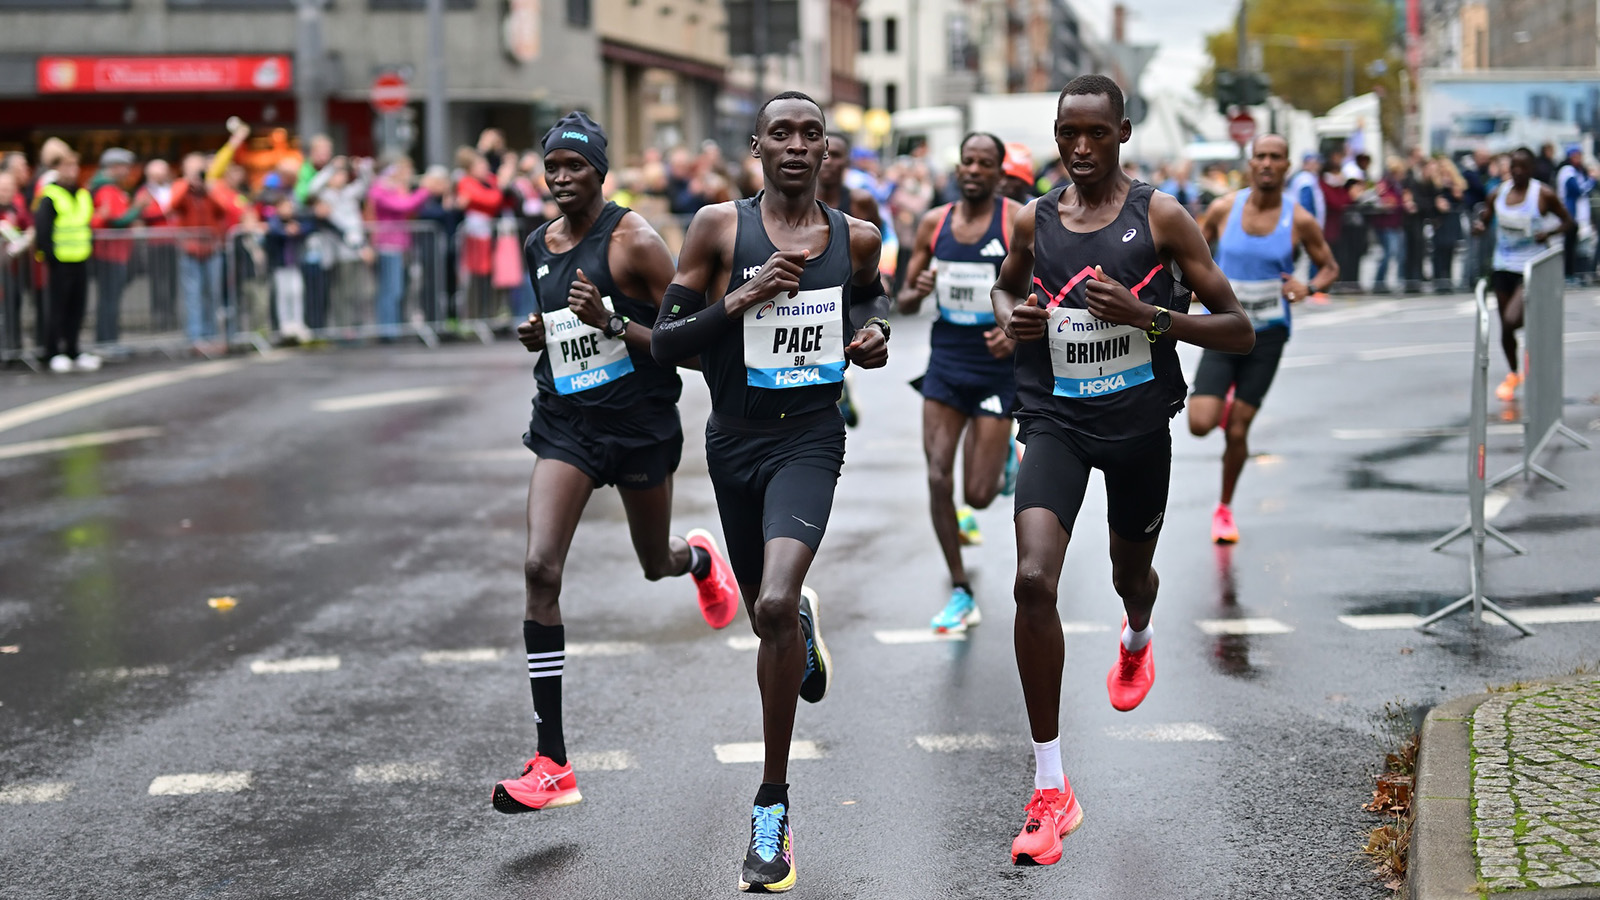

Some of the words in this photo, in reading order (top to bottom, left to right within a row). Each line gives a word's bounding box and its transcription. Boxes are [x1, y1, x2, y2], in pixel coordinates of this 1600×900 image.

[561, 131, 589, 143] HOKA
[743, 265, 764, 280] HO
[776, 301, 835, 316] mainova
[555, 316, 586, 333] main
[560, 333, 600, 363] PACE
[773, 325, 823, 354] PACE
[1066, 335, 1130, 364] BRIMIN
[580, 361, 588, 371] 97
[794, 355, 805, 366] 98
[570, 368, 610, 390] HOKA
[775, 368, 821, 385] HOKA
[1098, 366, 1103, 376] 1
[1079, 374, 1126, 395] HOKA
